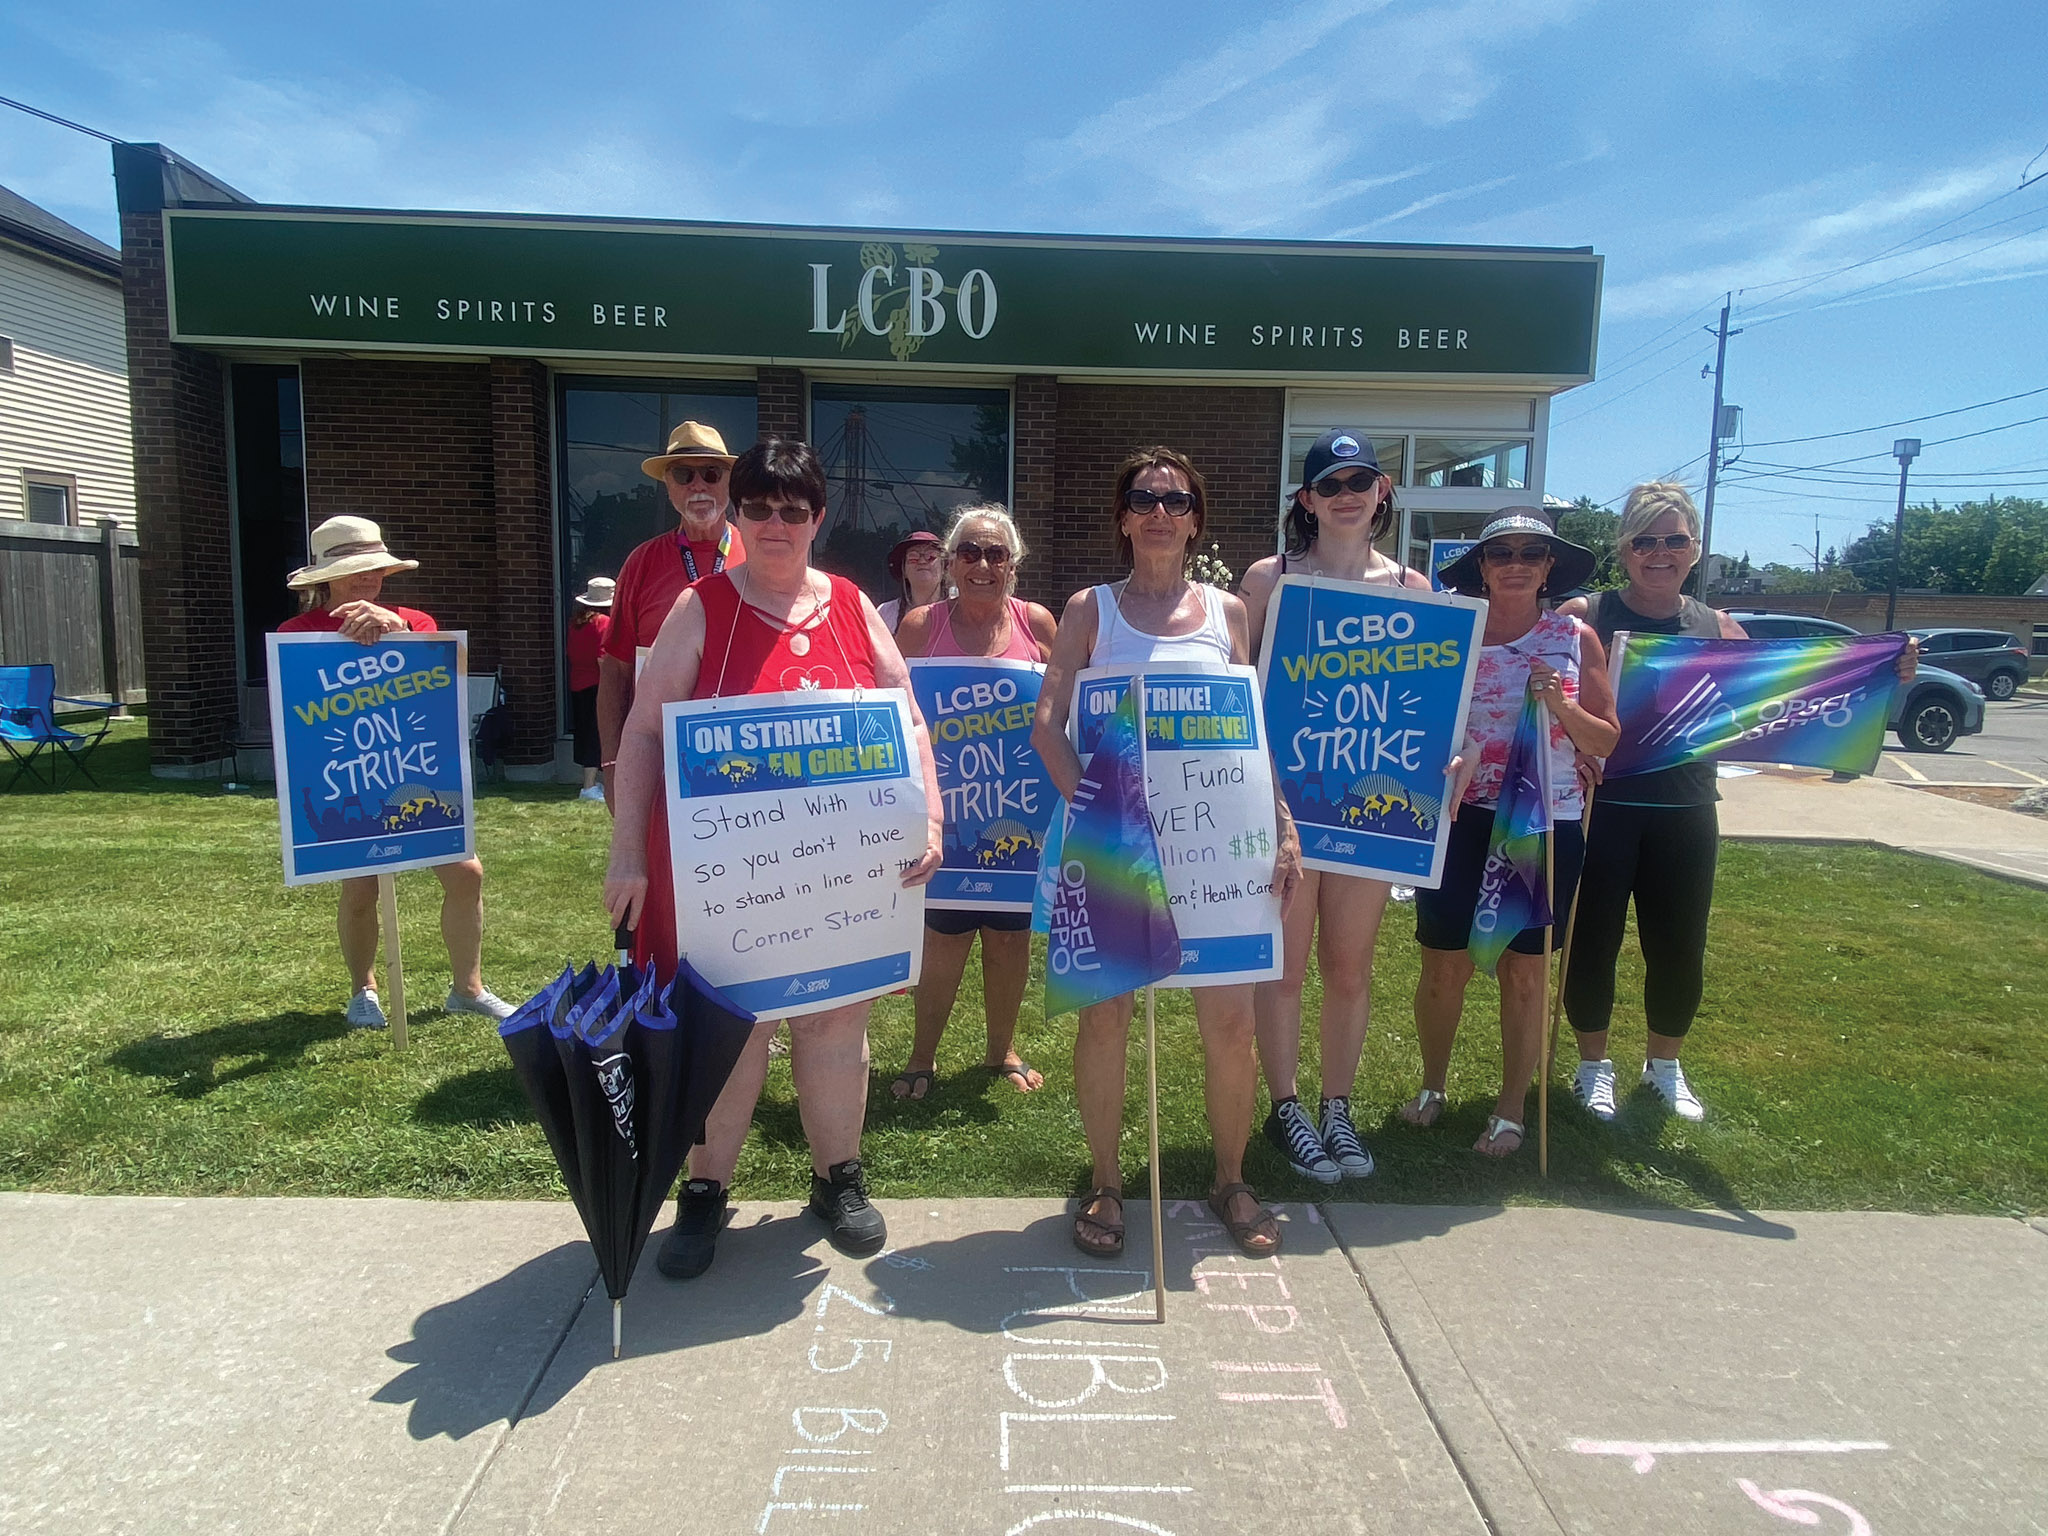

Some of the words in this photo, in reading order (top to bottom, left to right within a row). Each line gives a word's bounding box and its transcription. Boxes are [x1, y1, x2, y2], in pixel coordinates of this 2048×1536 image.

[310, 294, 401, 319] WINE
[436, 299, 557, 324] SPIRITS
[593, 304, 669, 329] BEER
[807, 262, 999, 340] LCBO
[1134, 322, 1217, 346] WINE
[1251, 324, 1364, 349] SPIRITS
[1398, 328, 1470, 351] BEER
[1443, 546, 1470, 559] LCBO
[1316, 611, 1415, 647] LCBO
[317, 649, 406, 692] LCBO
[1281, 639, 1461, 682] WORKERS
[293, 665, 451, 726] WORKERS
[935, 678, 1017, 715] LCBO
[1089, 690, 1117, 715] ON
[1145, 686, 1211, 712] TRIKE!
[1335, 680, 1390, 724] ON
[353, 707, 402, 750] ON
[694, 725, 733, 754] ON
[739, 715, 843, 750] STRIKE!
[930, 701, 1037, 745] ORKER
[1146, 716, 1175, 740] EN
[1181, 711, 1249, 740] GRÈVE!
[322, 740, 439, 801] STRIKE
[768, 752, 802, 777] EN
[808, 741, 896, 776] GRÈVE!
[958, 738, 1006, 780] ON
[1287, 725, 1426, 774] STRIKE
[1182, 756, 1245, 791] Fund
[691, 799, 786, 840] Stand
[804, 793, 848, 817] With
[940, 778, 1041, 823] TRIKE
[1150, 801, 1216, 837] VER
[742, 850, 780, 880] you
[792, 835, 837, 858] don't
[859, 828, 905, 847] have
[1161, 845, 1216, 866] llion
[1228, 827, 1270, 861] $$$
[703, 900, 725, 918] to
[735, 886, 786, 909] stand
[796, 883, 812, 895] in
[823, 873, 854, 889] line
[867, 863, 885, 879] at
[895, 858, 919, 871] the
[1203, 883, 1243, 904] Health
[1247, 880, 1274, 896] Care
[1052, 872, 1071, 975] EFPO
[1063, 860, 1101, 971] OPSEU
[732, 926, 814, 953] Corner
[1211, 1360, 1348, 1429] IT
